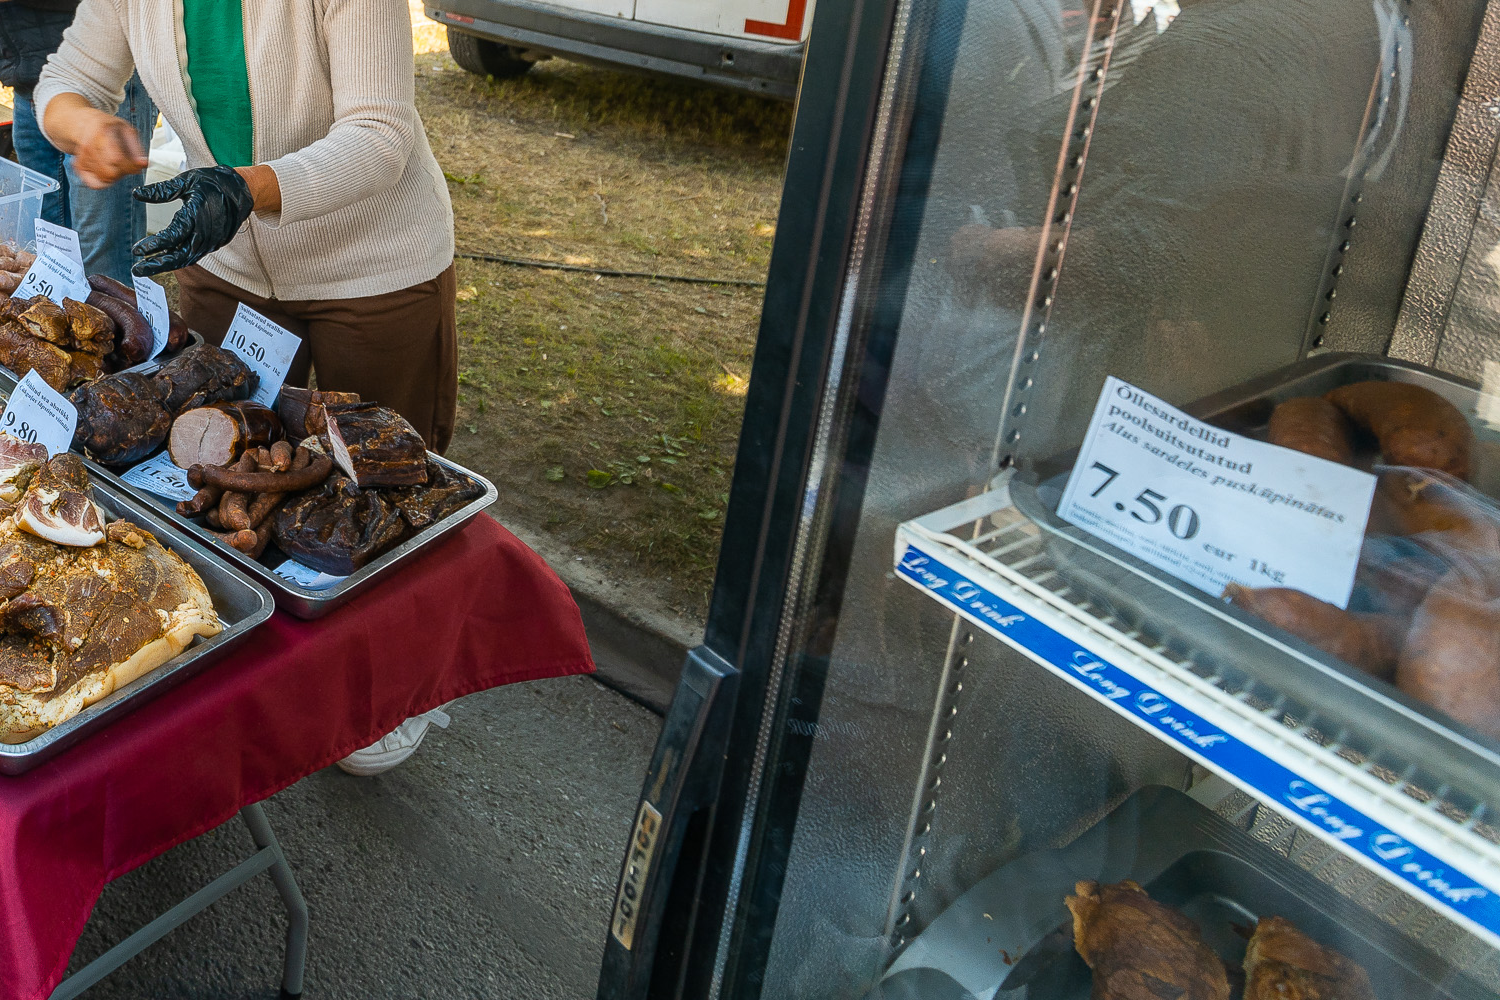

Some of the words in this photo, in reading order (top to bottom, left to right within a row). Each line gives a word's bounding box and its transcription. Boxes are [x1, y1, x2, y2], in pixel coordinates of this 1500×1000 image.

[26, 272, 54, 297] 9.50
[229, 330, 266, 362] 10.50
[4, 411, 38, 445] 9.80
[1101, 421, 1140, 445] Alus
[1143, 440, 1210, 480] sardeles
[1106, 404, 1254, 475] poolsuitsutatud
[140, 466, 186, 488] 11.50
[1089, 461, 1201, 540] 7.50
[1202, 541, 1238, 563] eur
[1249, 558, 1287, 585] 1kg
[898, 550, 949, 590] Long
[952, 579, 1026, 629] Drink
[1067, 650, 1132, 700] Long
[1134, 688, 1230, 749] Drink
[1282, 780, 1364, 840] Long
[1367, 830, 1489, 903] Drink
